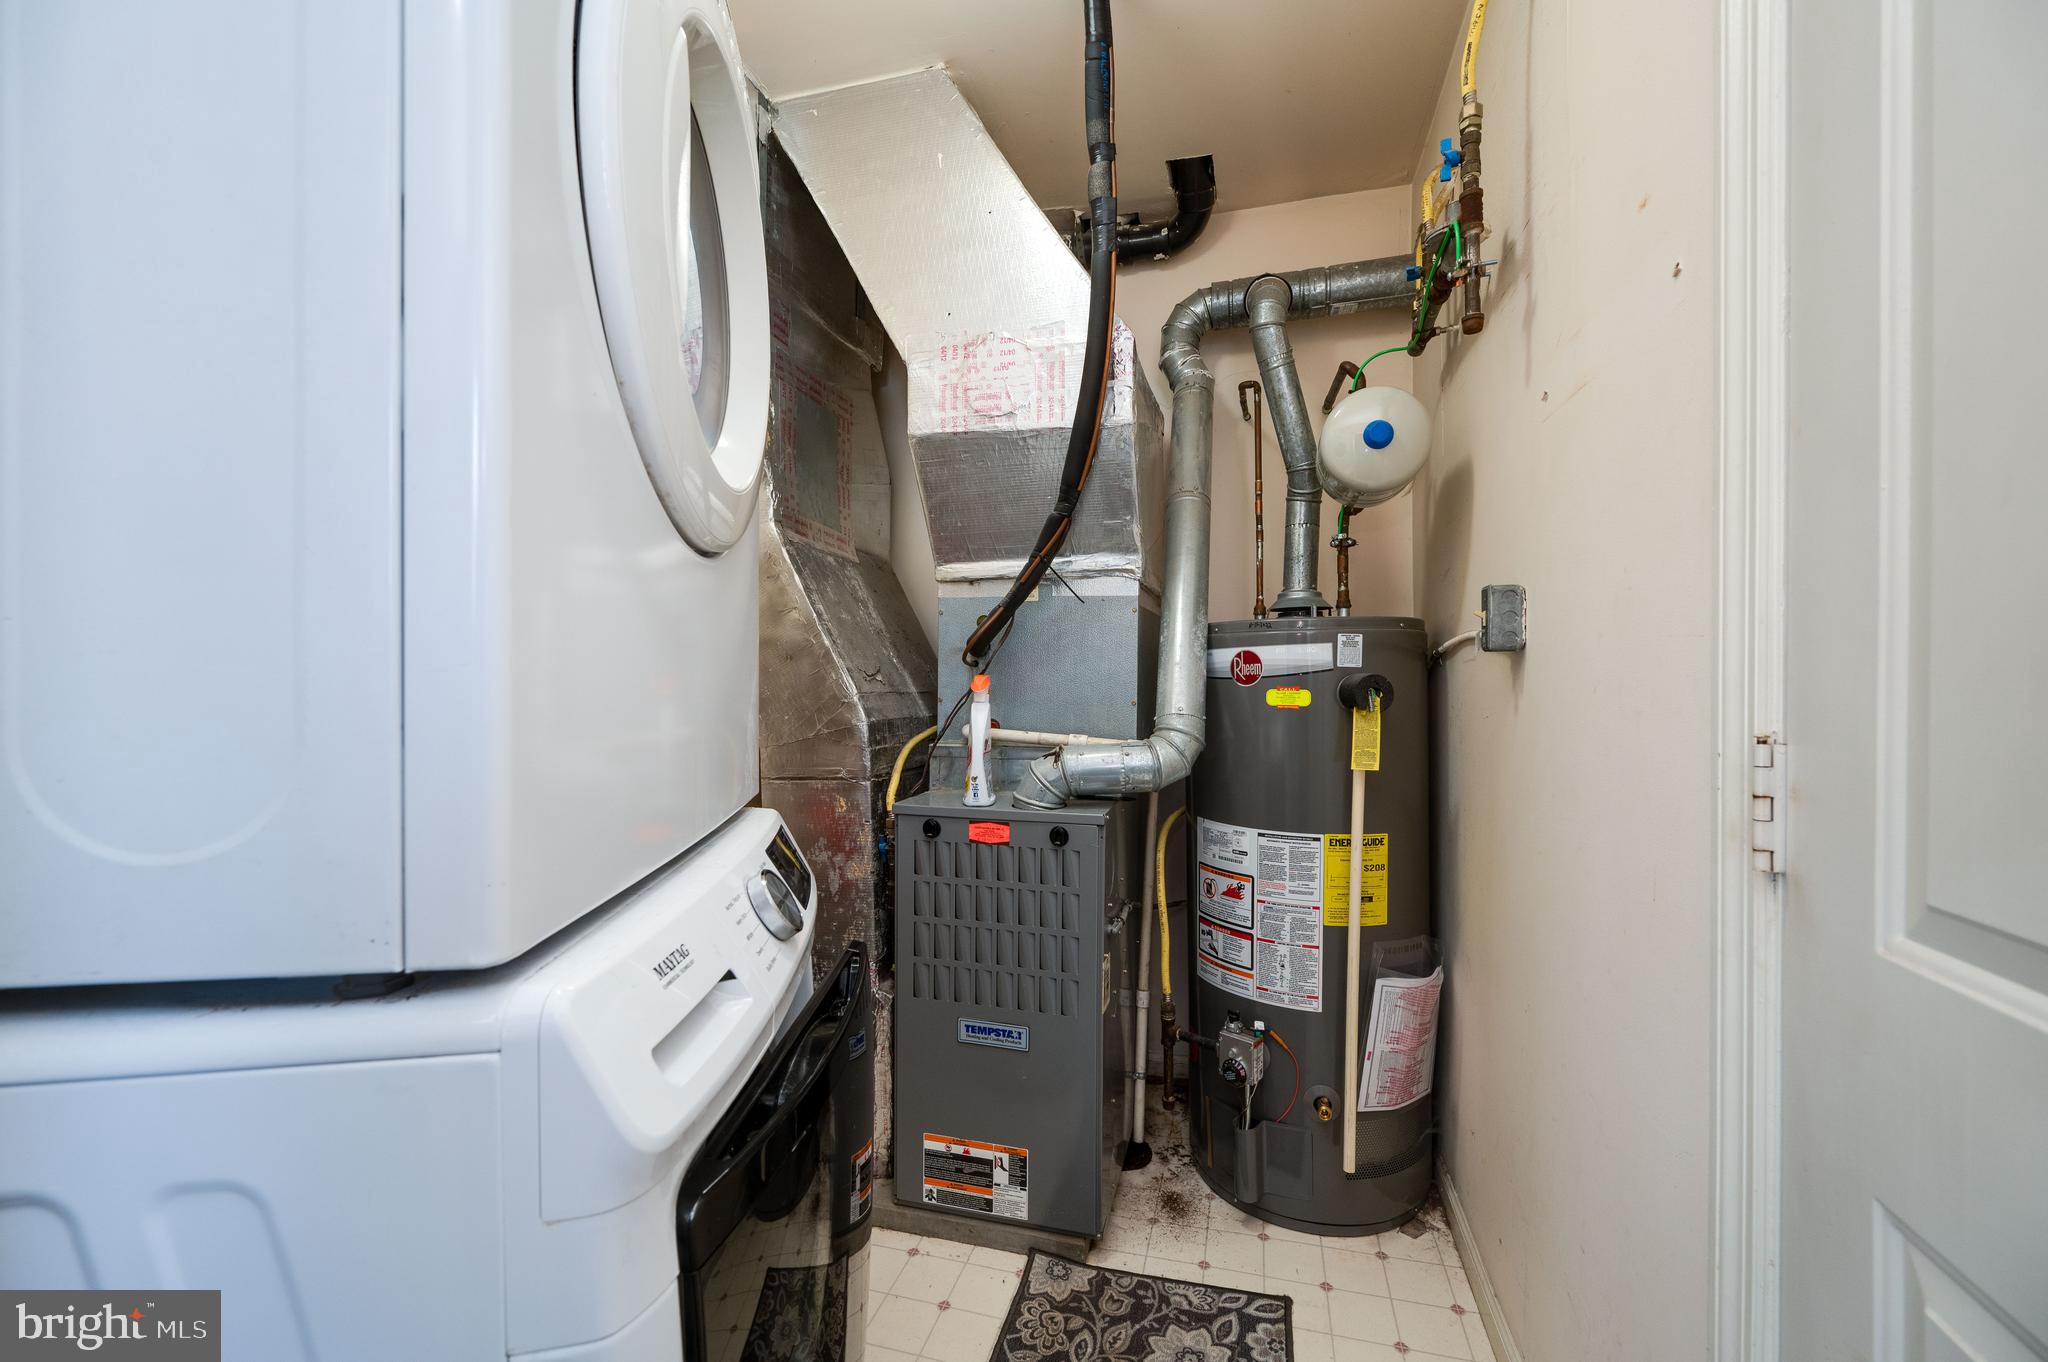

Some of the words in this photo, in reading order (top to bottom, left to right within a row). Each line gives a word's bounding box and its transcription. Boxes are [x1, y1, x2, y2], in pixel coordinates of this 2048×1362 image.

[1233, 651, 1262, 681] Rheem
[1363, 863, 1386, 872] $208
[652, 943, 690, 981] MAYTAG
